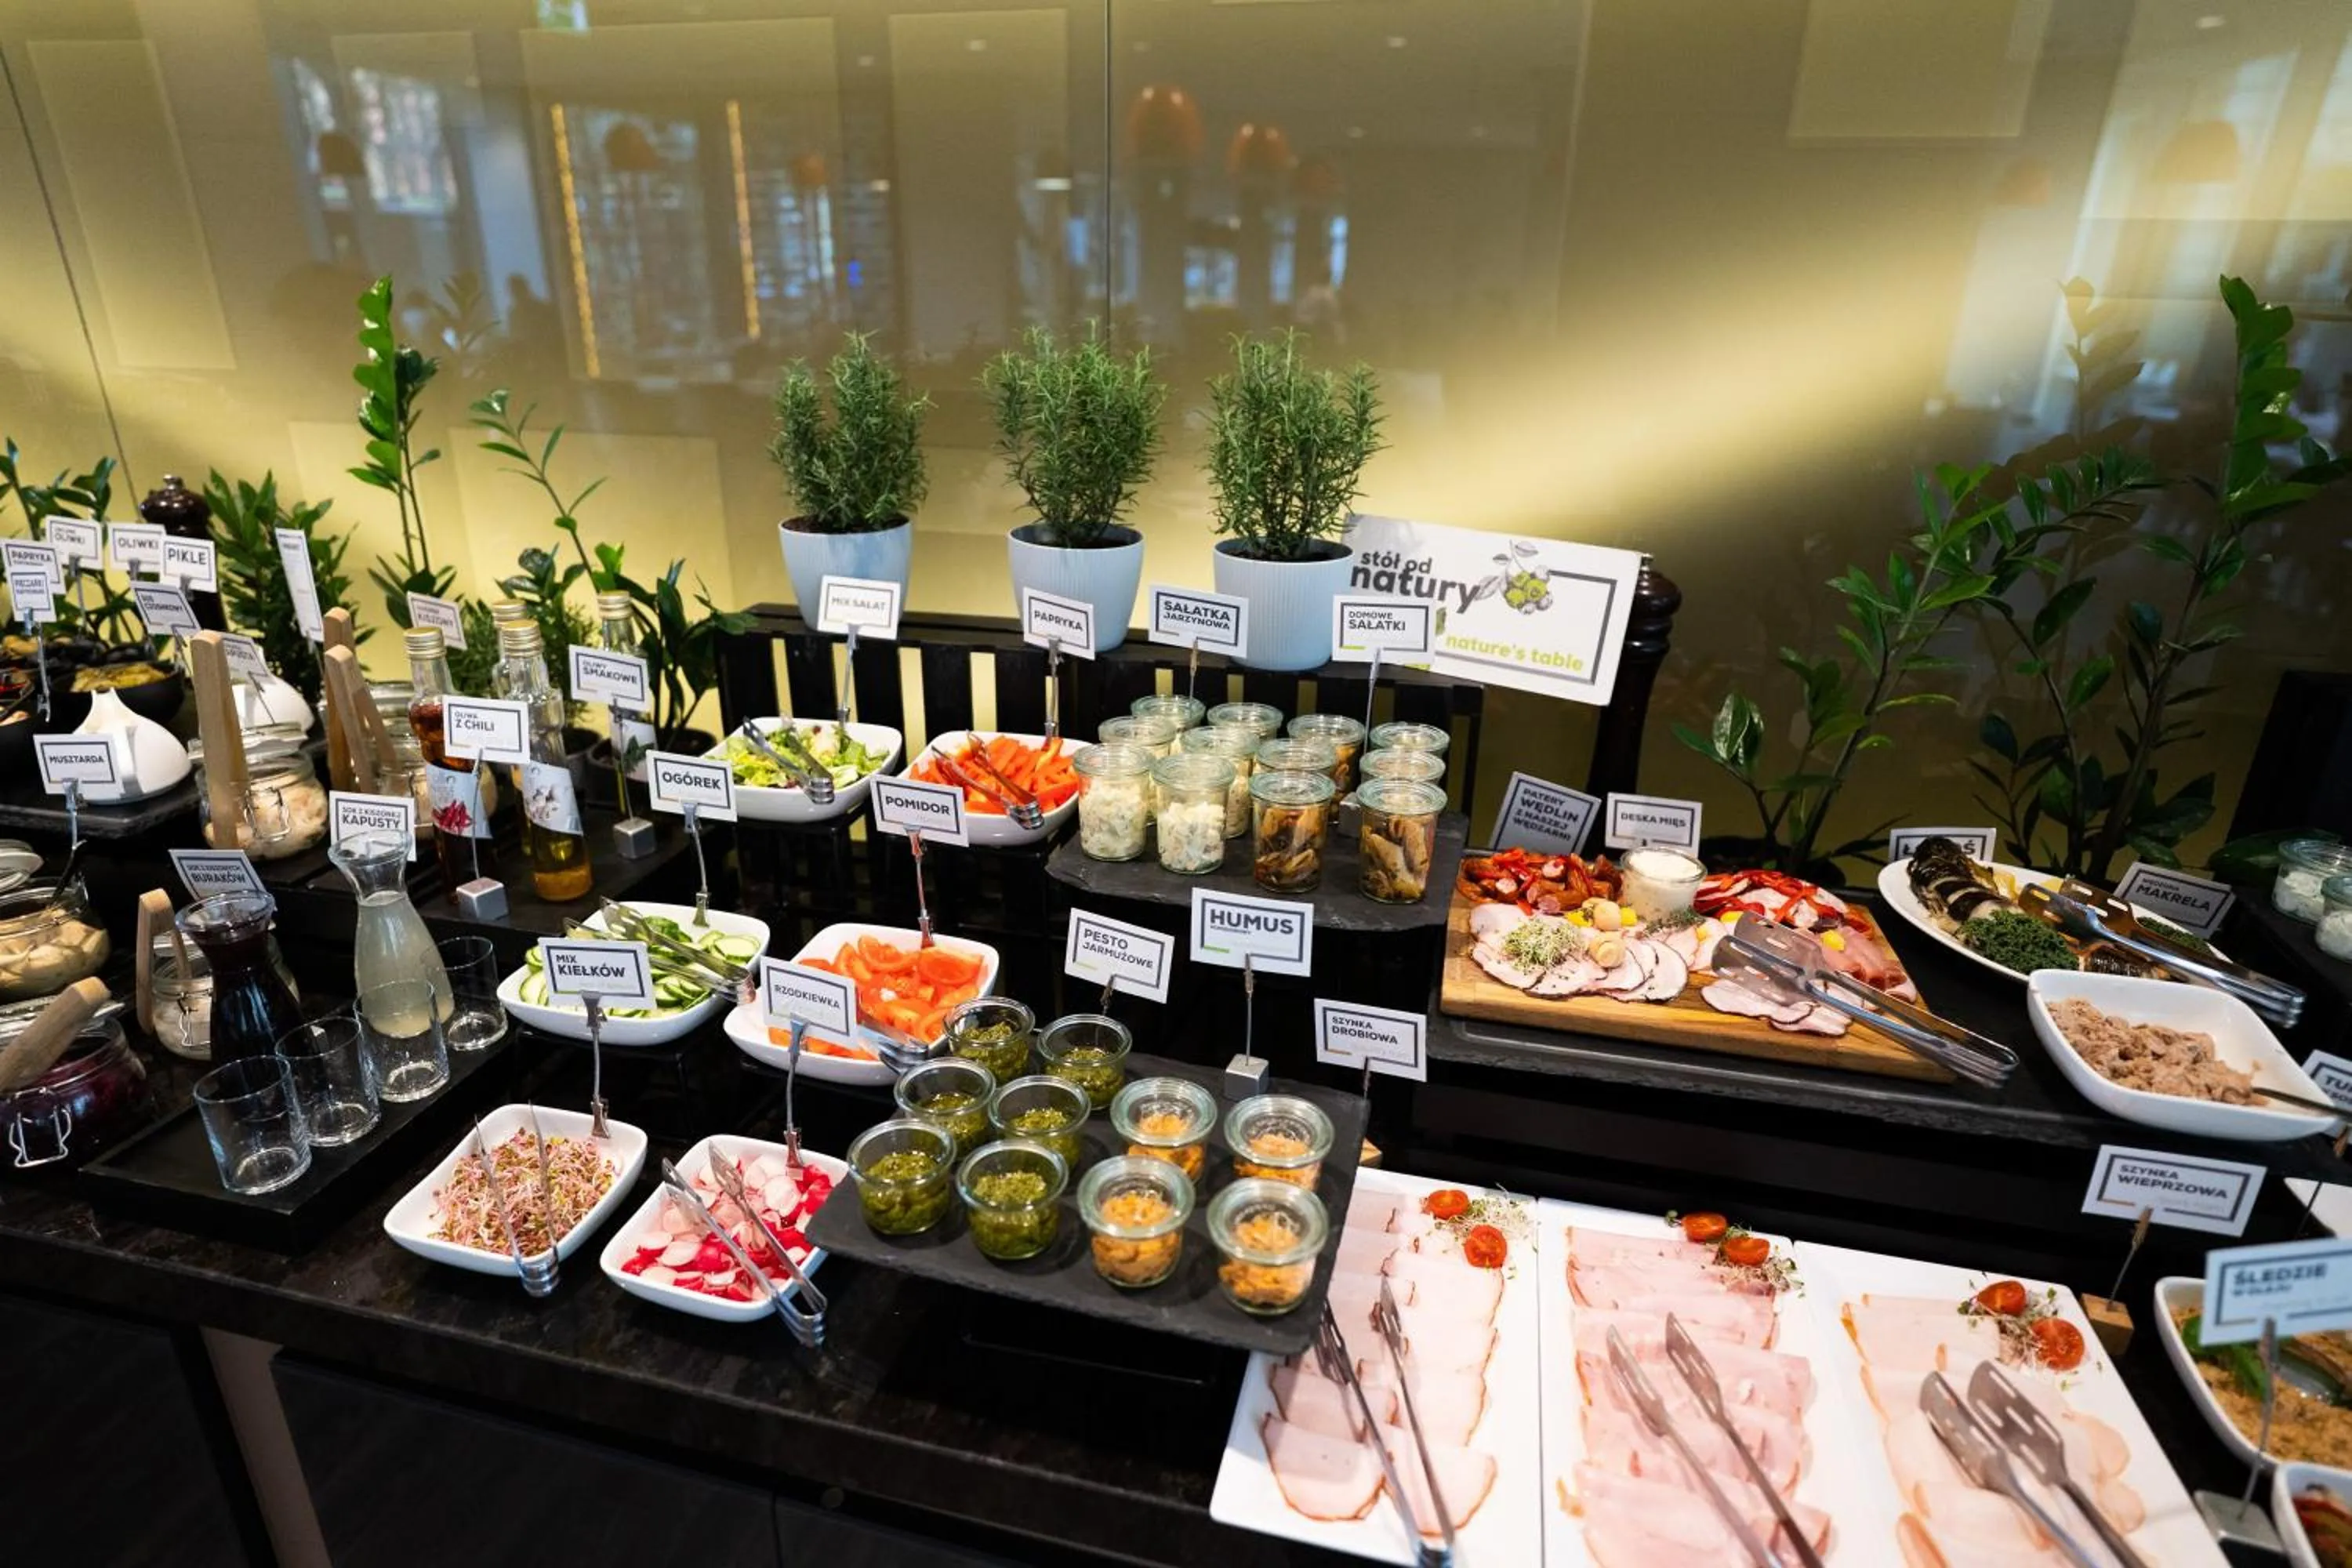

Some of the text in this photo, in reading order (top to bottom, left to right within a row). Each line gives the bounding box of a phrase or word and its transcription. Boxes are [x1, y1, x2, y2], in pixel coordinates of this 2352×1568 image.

[118, 538, 158, 549] OLIWKI
[12, 550, 53, 562] PAPRYKA
[168, 548, 207, 564] PIKLE
[1360, 550, 1433, 575] stół od
[1350, 565, 1481, 615] natury
[831, 596, 850, 605] MIX
[1034, 609, 1083, 632] PAPRYKA
[1163, 600, 1231, 622] SAŁATKA
[1348, 611, 1393, 619] DOMOWE
[1163, 612, 1230, 630] JARZYNOWA
[1348, 619, 1406, 631] SAŁATKI
[1446, 634, 1584, 672] nature's table
[583, 666, 637, 684] SMAKOWE
[456, 719, 495, 731] Z CHILI
[49, 755, 104, 764] MUSZTARDA
[662, 771, 721, 790] OGÓREK
[885, 796, 951, 815] POMIDOR
[1523, 788, 1566, 807] PATERY
[1520, 797, 1580, 823] WĘDLIN
[342, 814, 401, 829] KAPUSTY
[1525, 811, 1569, 830] NASZEJ
[1620, 812, 1686, 829] DESKA MIĘS
[2135, 884, 2211, 912] MAKRELA
[1210, 908, 1294, 935] HUMUS
[1083, 927, 1129, 950] PESTO
[556, 954, 577, 964] MIX
[1082, 942, 1154, 969] JARMUŻOWE
[557, 962, 626, 978] KIEŁKÓW
[774, 984, 841, 1009] RZODKIEWKA
[1332, 1015, 1373, 1029] SZYNKA
[1332, 1025, 1399, 1045] DROBIOWA
[2119, 1164, 2180, 1180] SZYNKA
[2117, 1174, 2228, 1200] WIEPRZOWA
[2234, 1263, 2328, 1286] ŚLEDZIE
